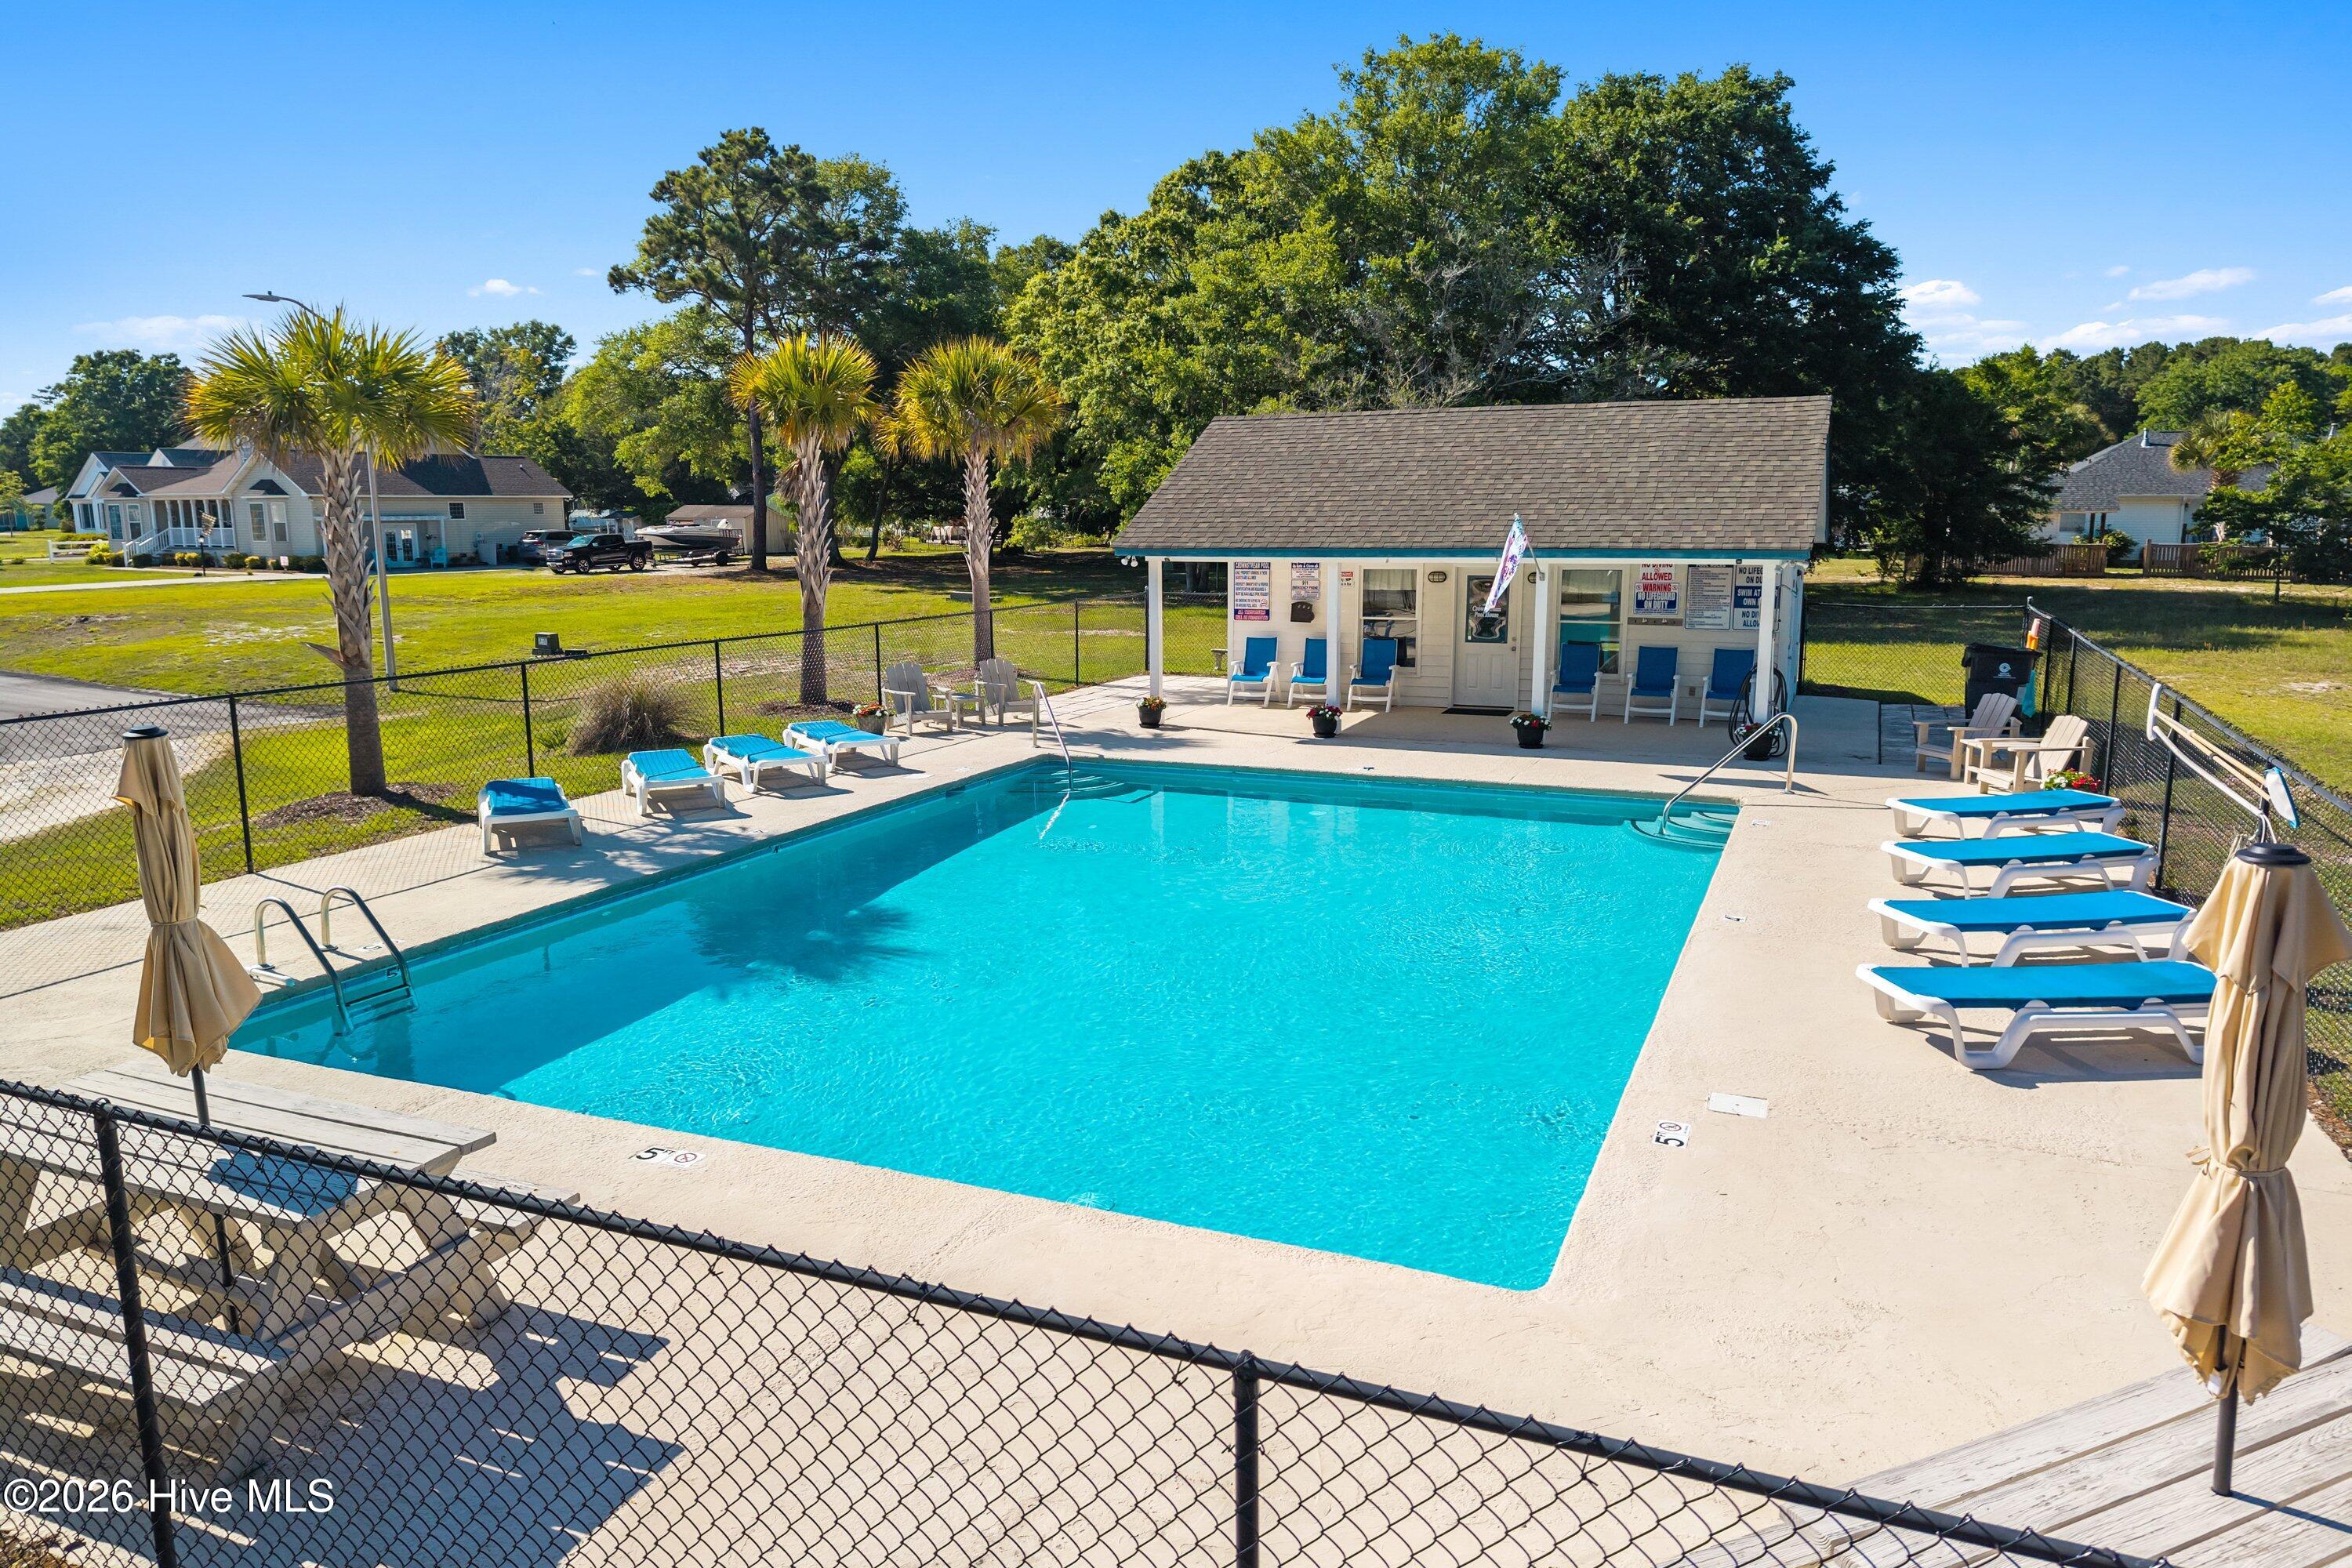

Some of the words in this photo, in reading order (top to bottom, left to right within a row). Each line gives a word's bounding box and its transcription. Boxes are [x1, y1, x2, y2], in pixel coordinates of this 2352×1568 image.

[1642, 583, 1671, 592] WARNING
[1655, 1136, 1684, 1147] 5
[636, 1147, 665, 1160] 5
